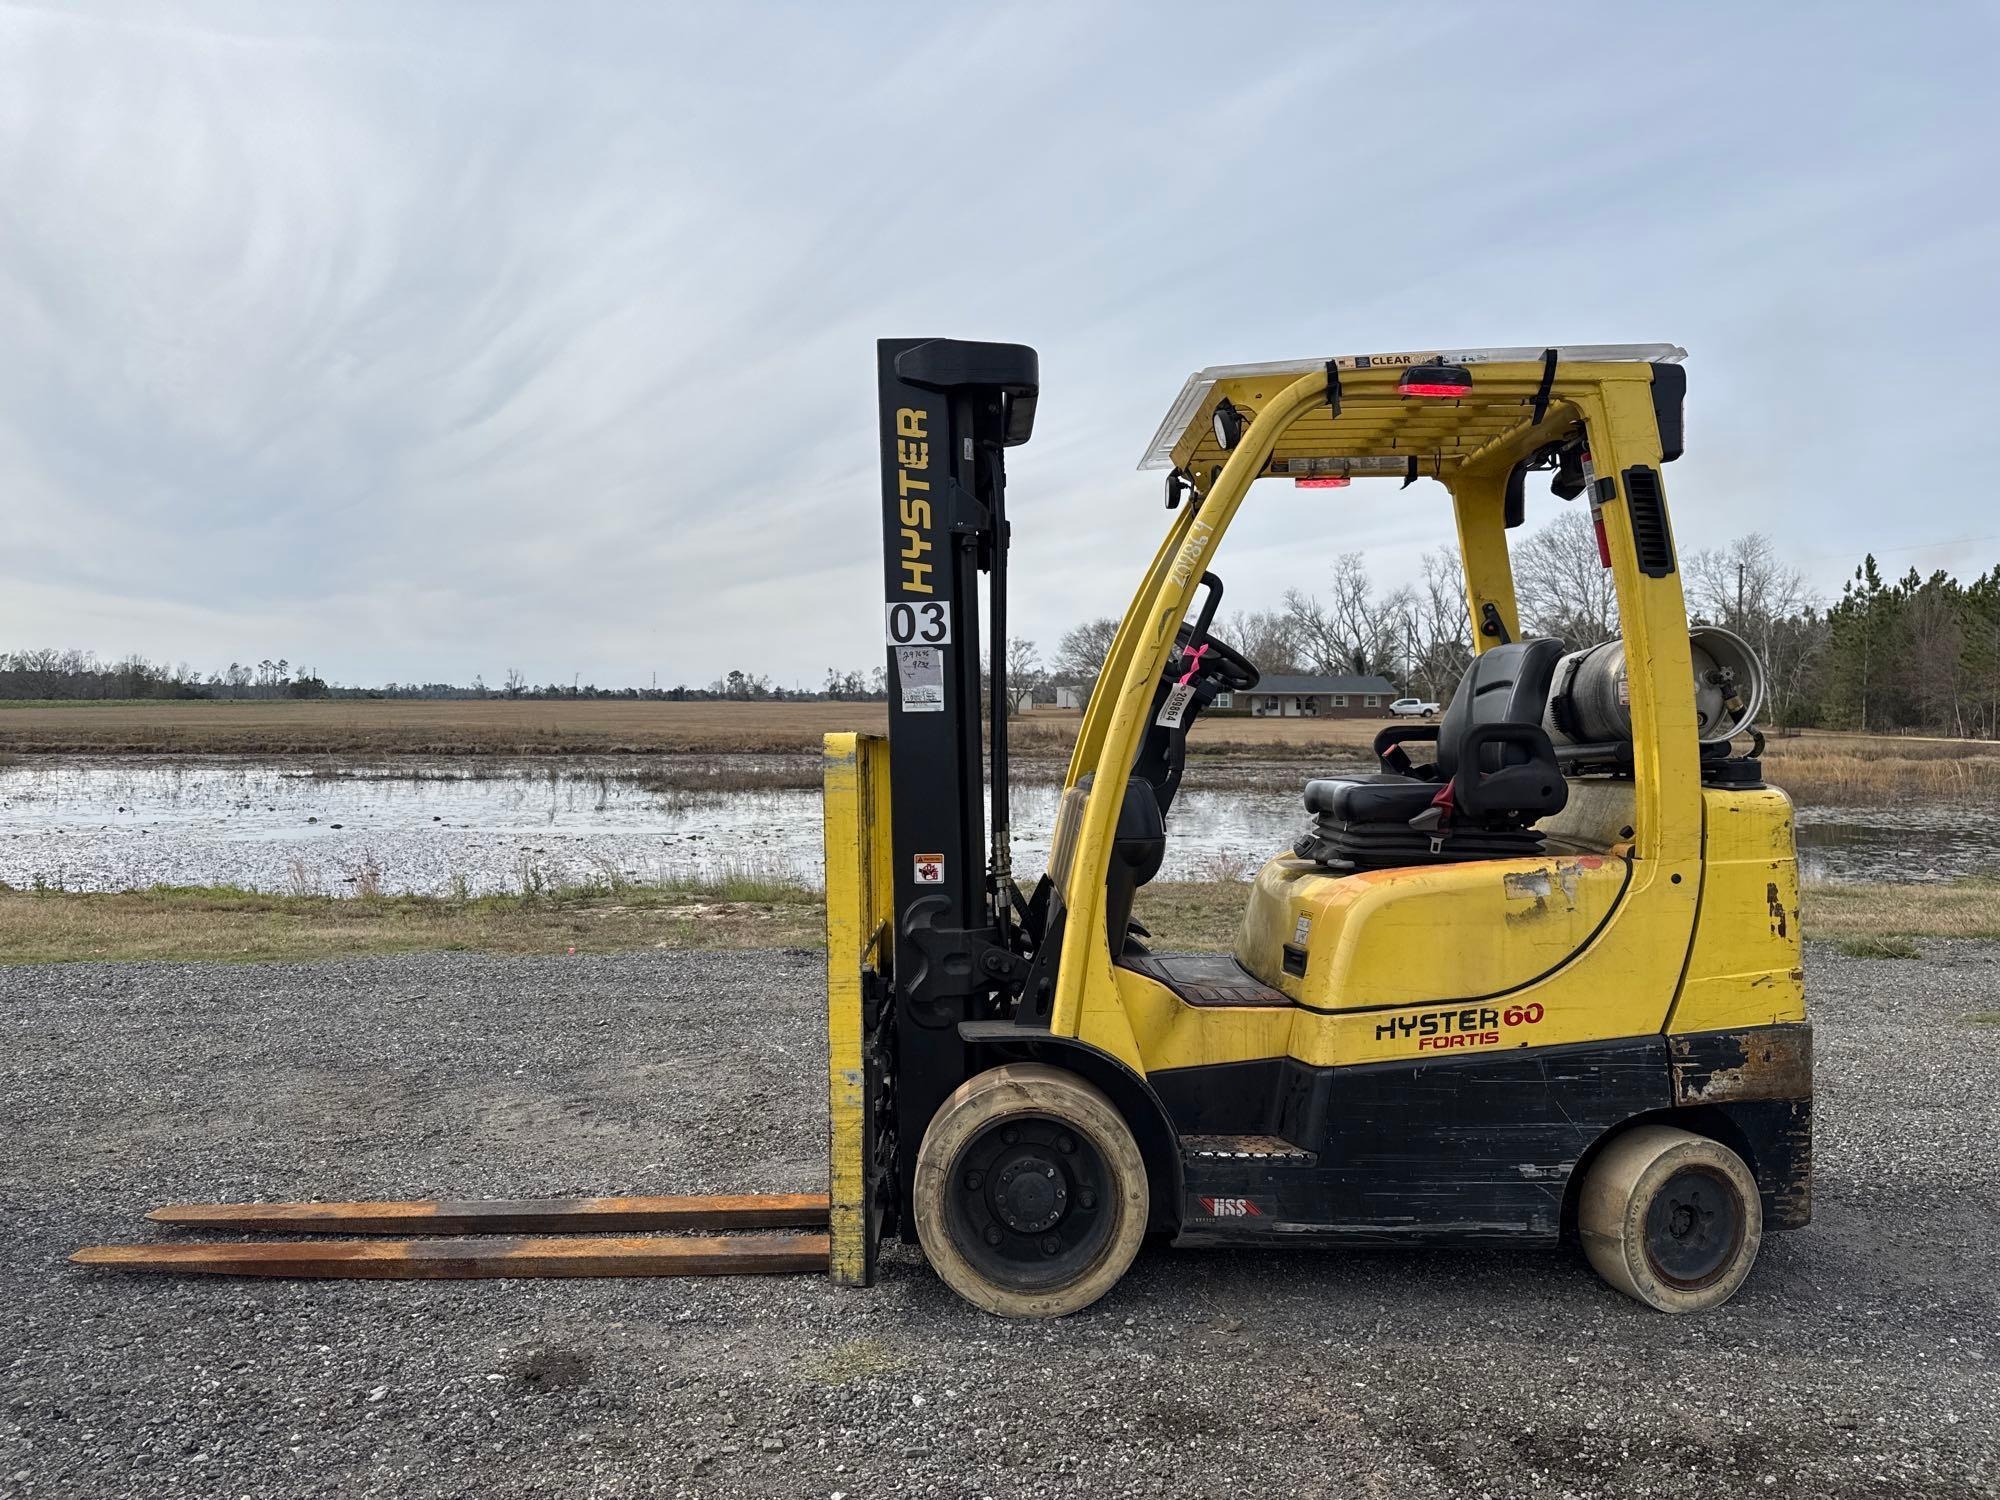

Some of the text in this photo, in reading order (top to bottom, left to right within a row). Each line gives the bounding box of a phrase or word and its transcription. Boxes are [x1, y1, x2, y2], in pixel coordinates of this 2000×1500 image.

[896, 407, 933, 594] HYSTER
[890, 602, 946, 643] 03
[1166, 692, 1187, 721] 209864
[1375, 1002, 1544, 1041] HYSTER 60
[1418, 1031, 1499, 1051] FORTIS
[1213, 1198, 1247, 1217] HSS
